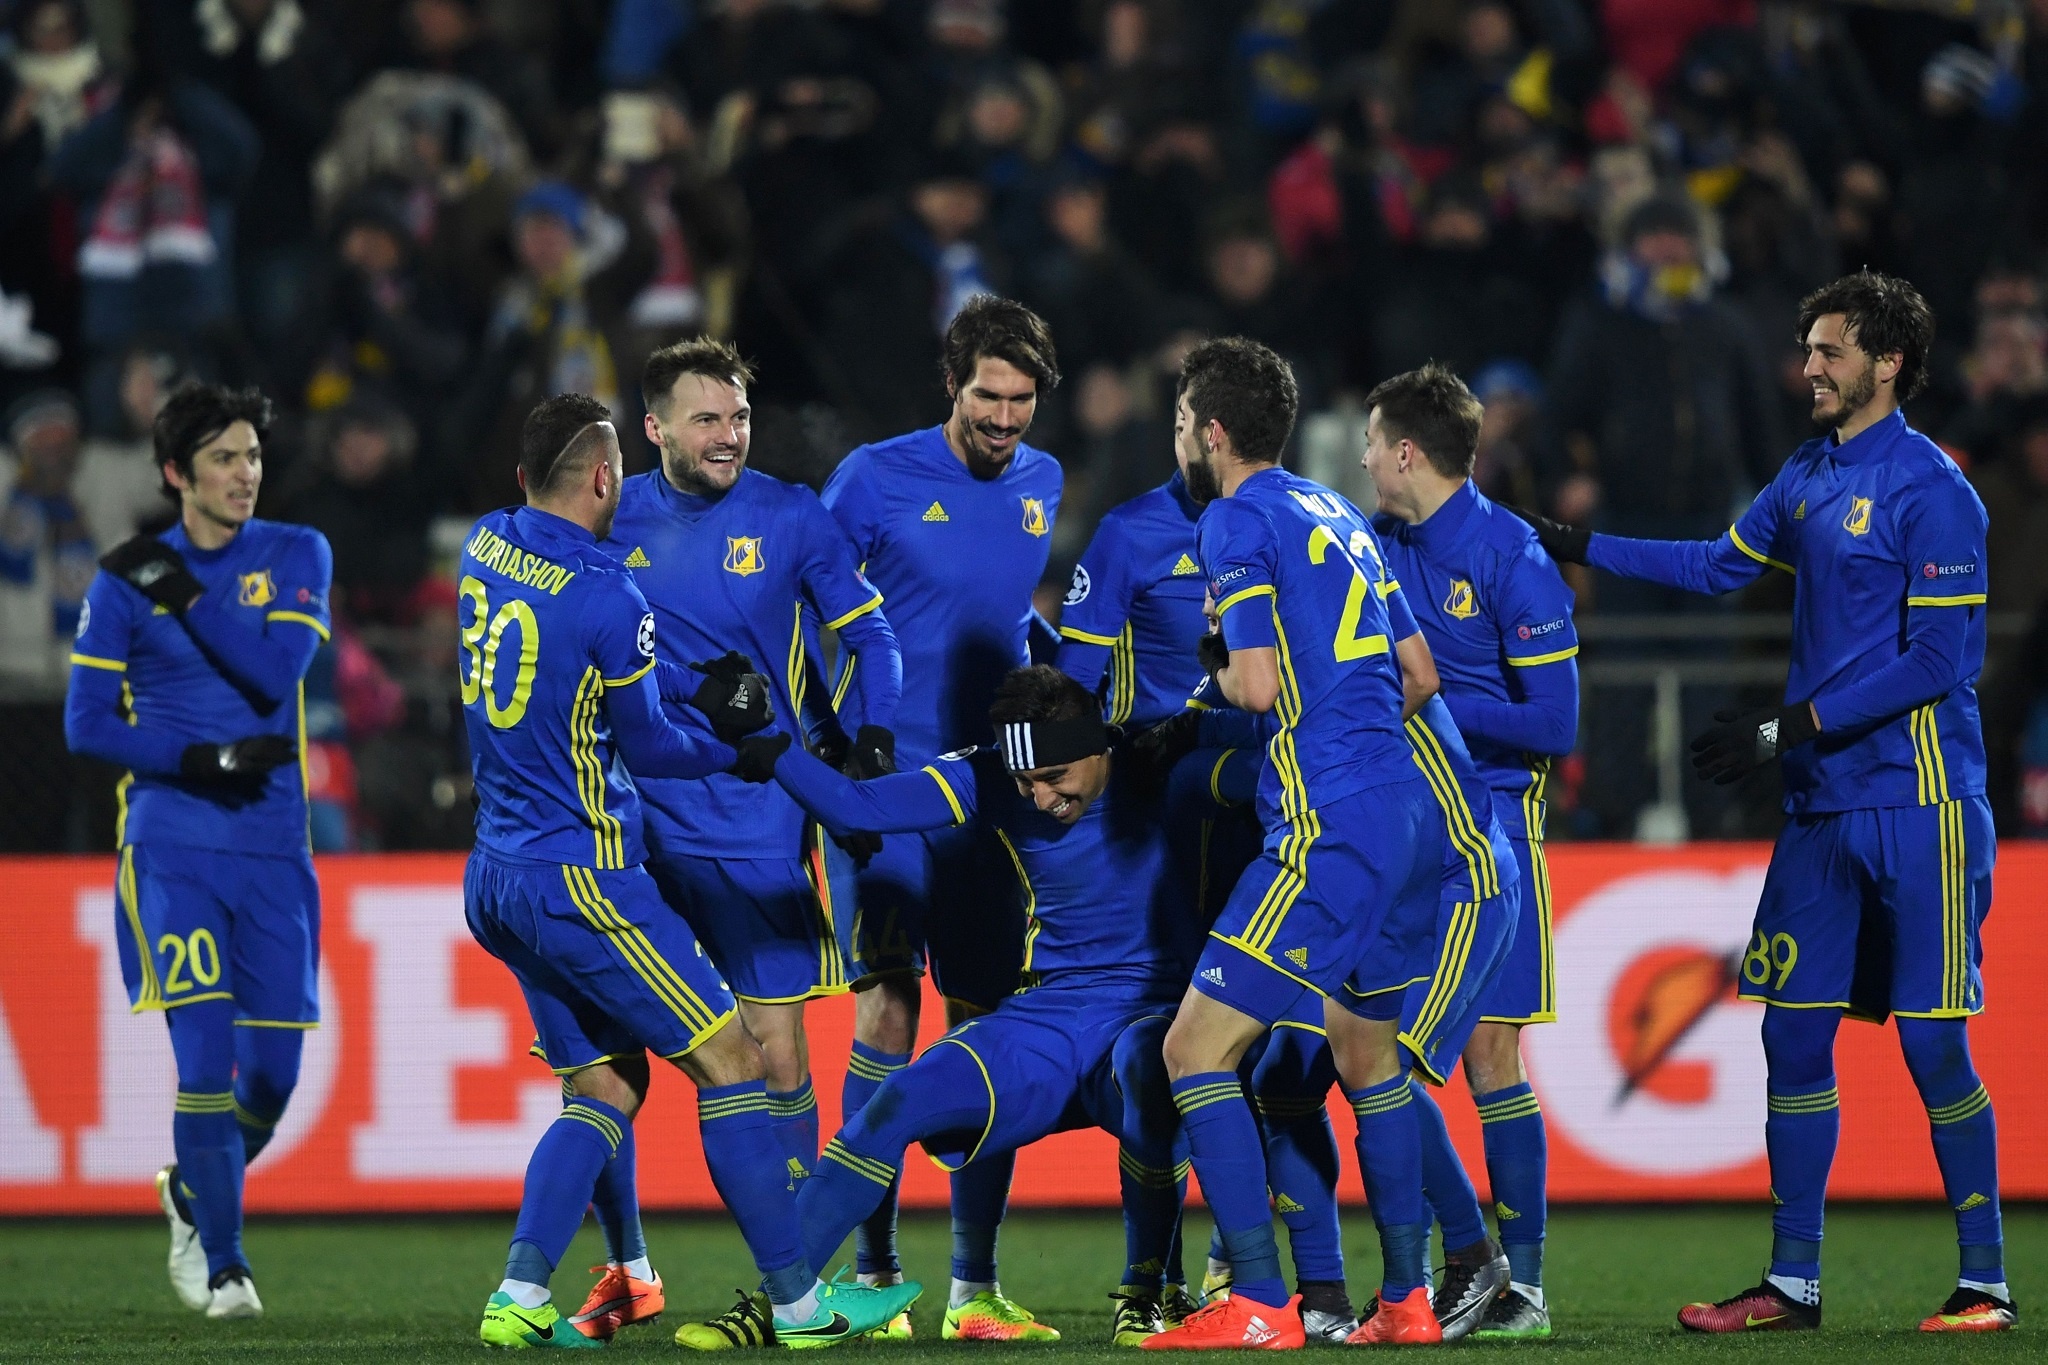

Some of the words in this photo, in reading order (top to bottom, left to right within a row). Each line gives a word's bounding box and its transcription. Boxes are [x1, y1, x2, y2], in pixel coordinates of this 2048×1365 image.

[922, 514, 950, 522] adidas
[1172, 565, 1200, 576] adidas
[1216, 566, 1247, 587] ESPECT
[1938, 564, 1975, 575] RESPECT
[1531, 619, 1565, 636] RESPECT
[459, 574, 540, 729] 30
[157, 927, 221, 994] 20
[1284, 950, 1308, 970] adidas
[1743, 928, 1798, 991] 89
[1200, 971, 1226, 988] adidas
